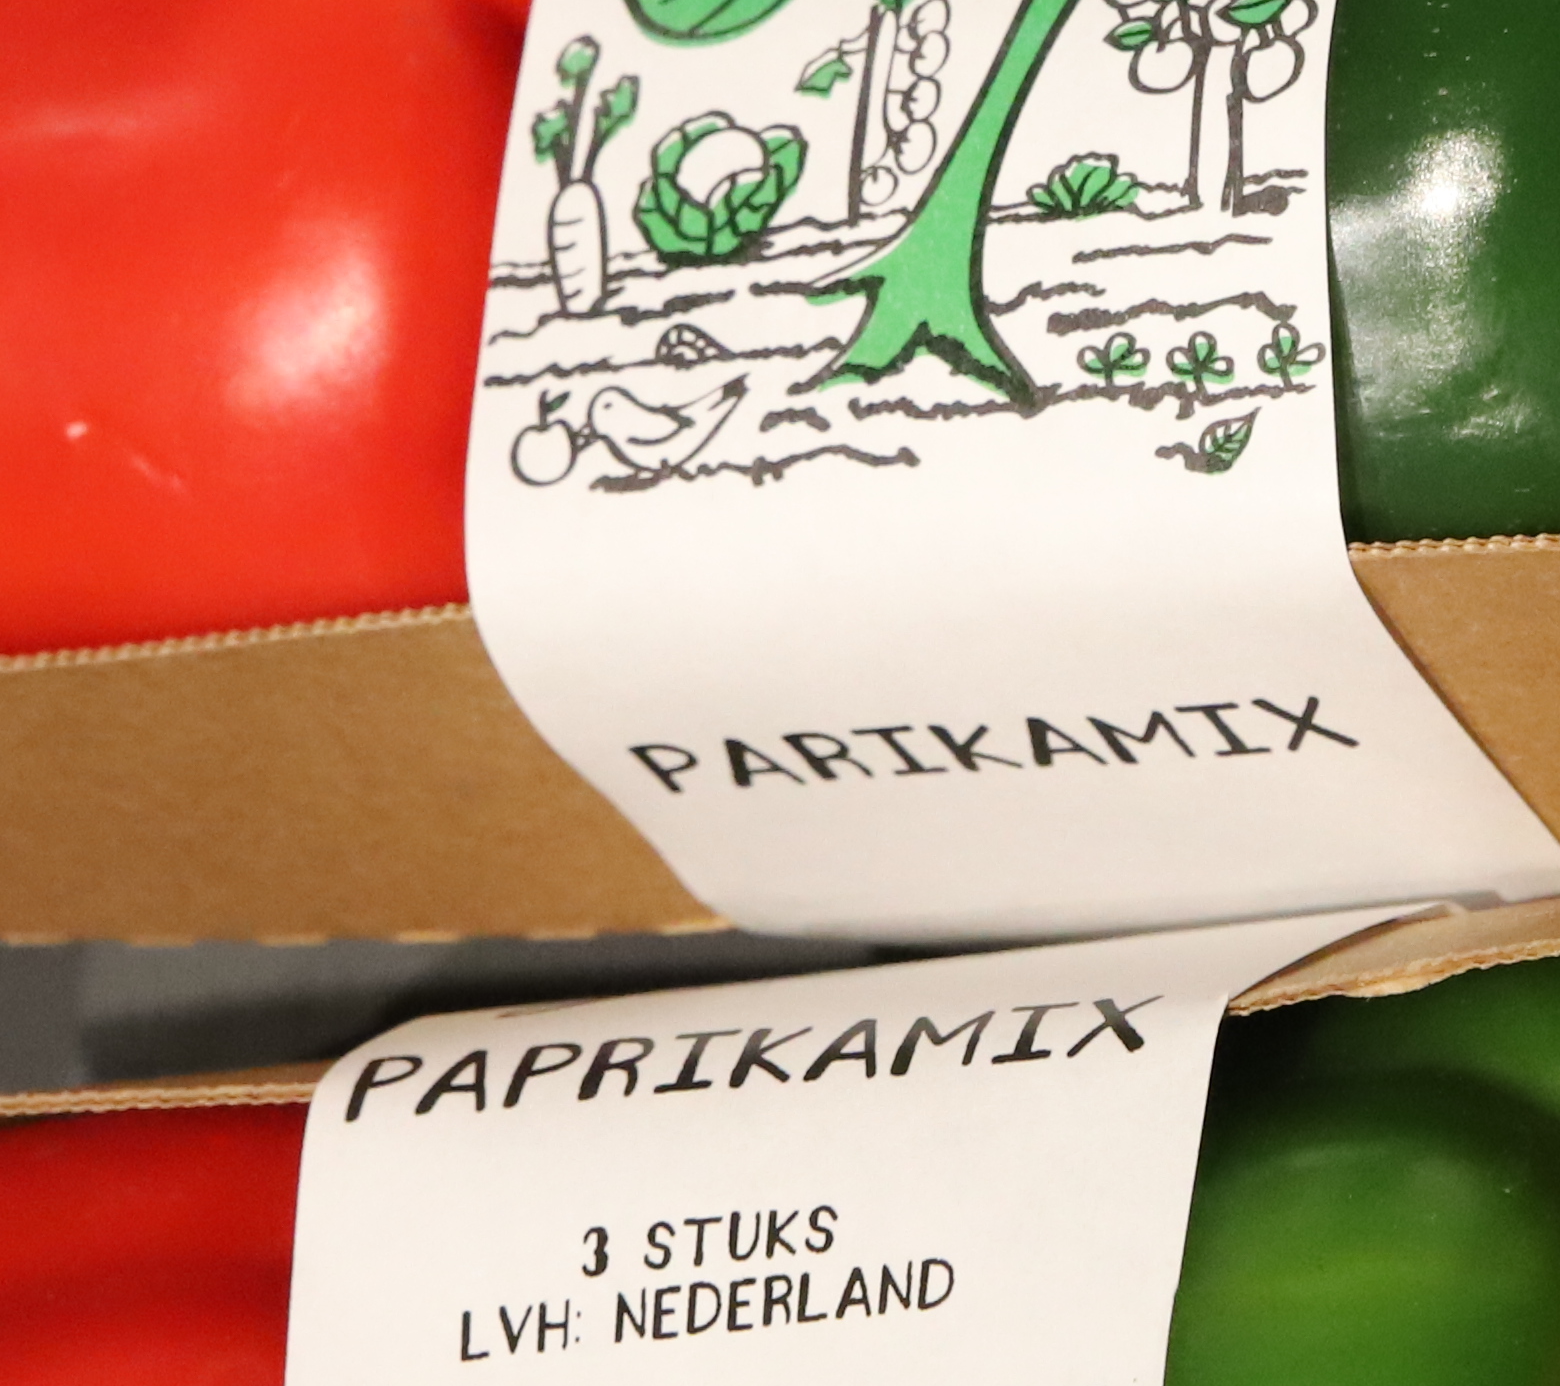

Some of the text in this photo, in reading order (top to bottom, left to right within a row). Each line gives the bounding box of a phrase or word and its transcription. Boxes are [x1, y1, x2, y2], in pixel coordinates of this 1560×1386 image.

[630, 695, 1359, 794] PARIKAMIX
[344, 995, 1164, 1123] PAPRIKAMIX
[582, 1205, 839, 1277] 3 STUKS
[459, 1257, 956, 1362] LVH: NEDERLAND
